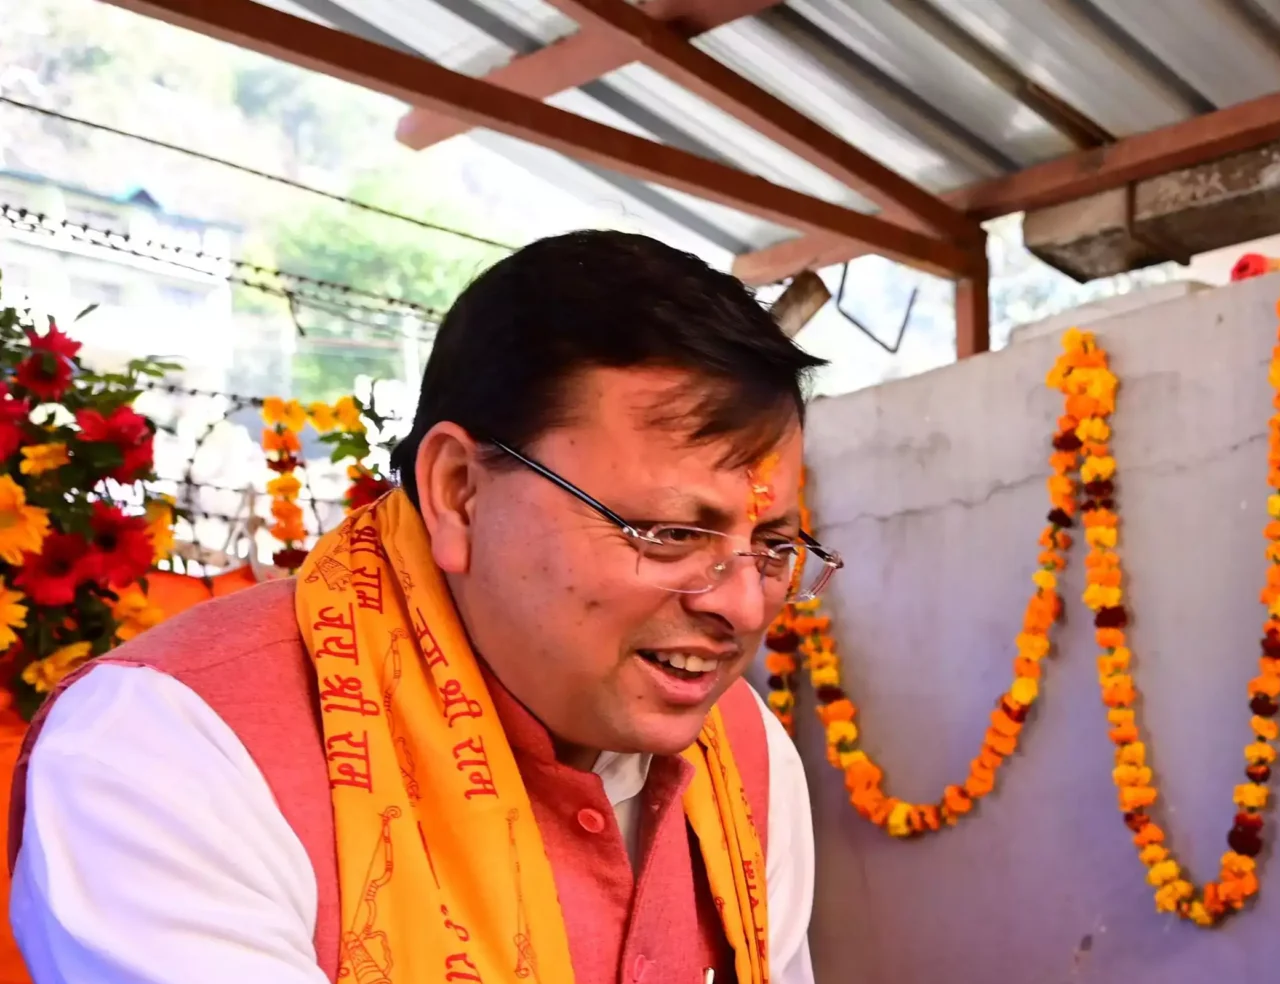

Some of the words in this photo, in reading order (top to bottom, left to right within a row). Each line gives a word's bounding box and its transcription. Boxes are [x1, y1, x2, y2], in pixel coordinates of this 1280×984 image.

[352, 567, 384, 614] राम
[314, 602, 358, 665] जय
[320, 673, 380, 717] श्री
[439, 679, 483, 728] श्री
[326, 730, 373, 793] राम
[452, 734, 499, 800] राम
